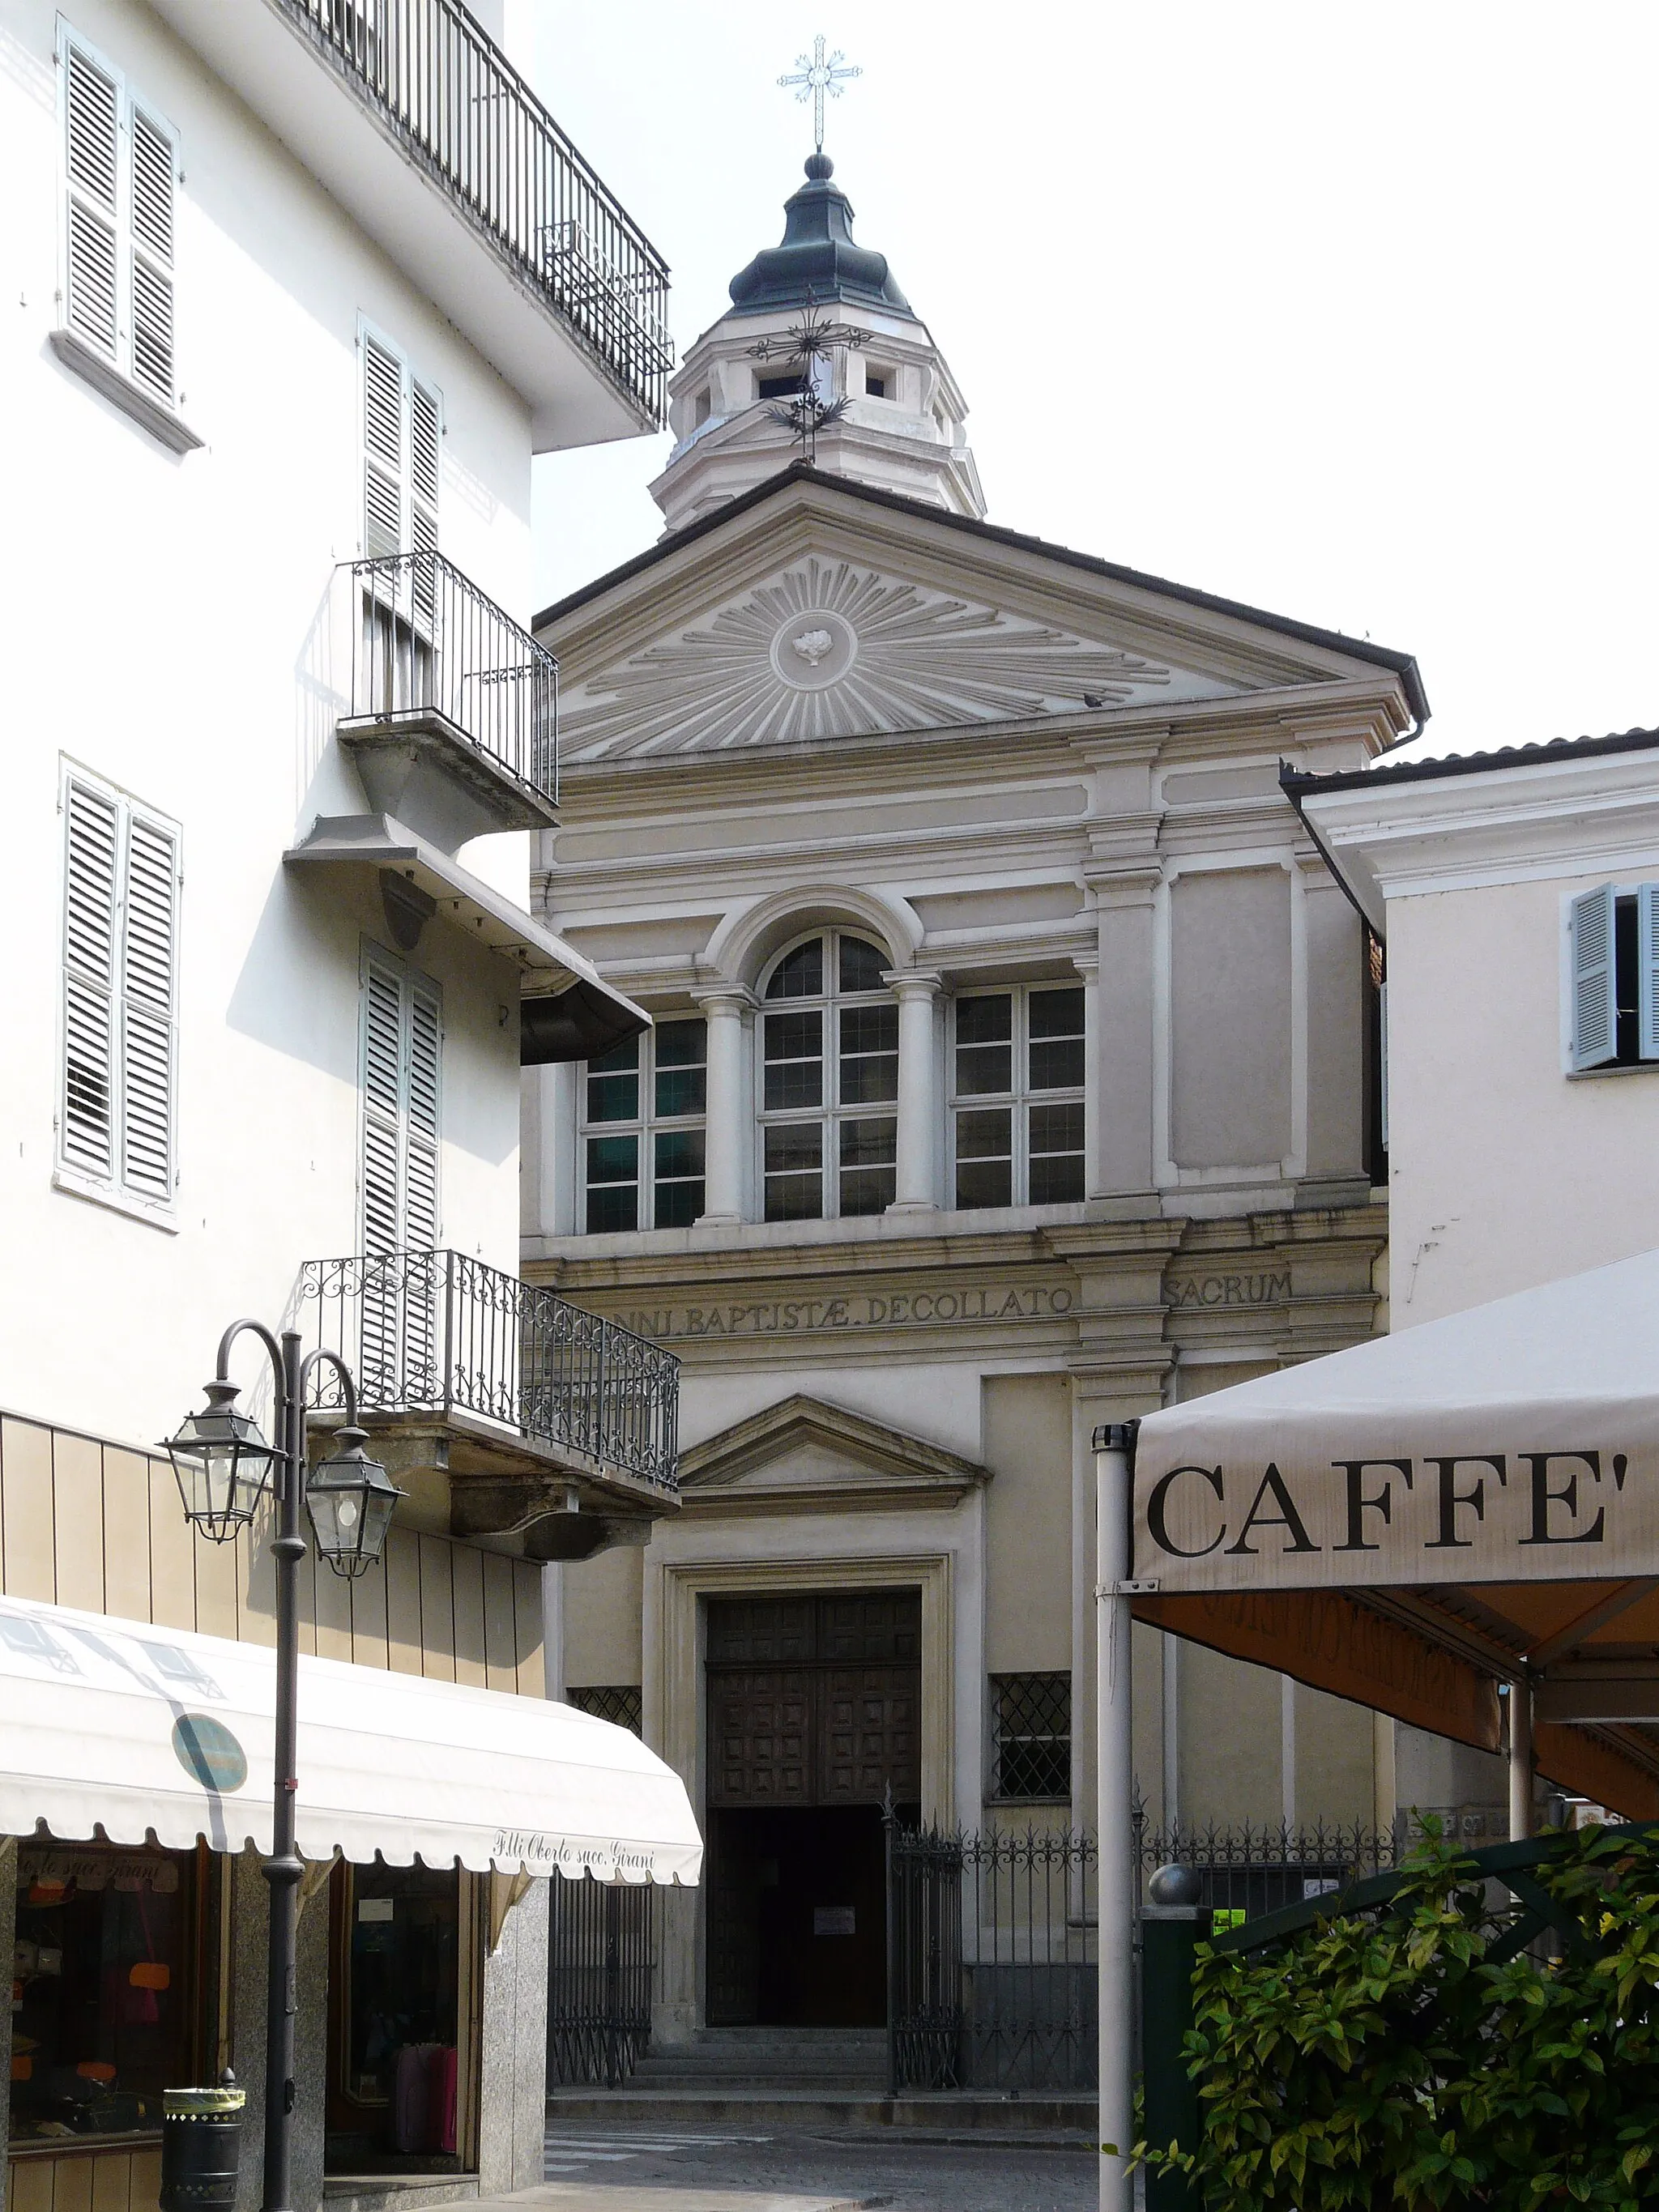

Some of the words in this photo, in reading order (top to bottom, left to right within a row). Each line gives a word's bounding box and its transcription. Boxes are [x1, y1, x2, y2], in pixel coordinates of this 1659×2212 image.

[868, 1287, 1073, 1324] DECOLLATO
[1165, 1271, 1293, 1306] SACRUM
[1147, 1450, 1628, 1558] CAFFE'
[527, 1833, 572, 1862] Oberto
[577, 1849, 608, 1865] succ.
[611, 1840, 657, 1869] Girani
